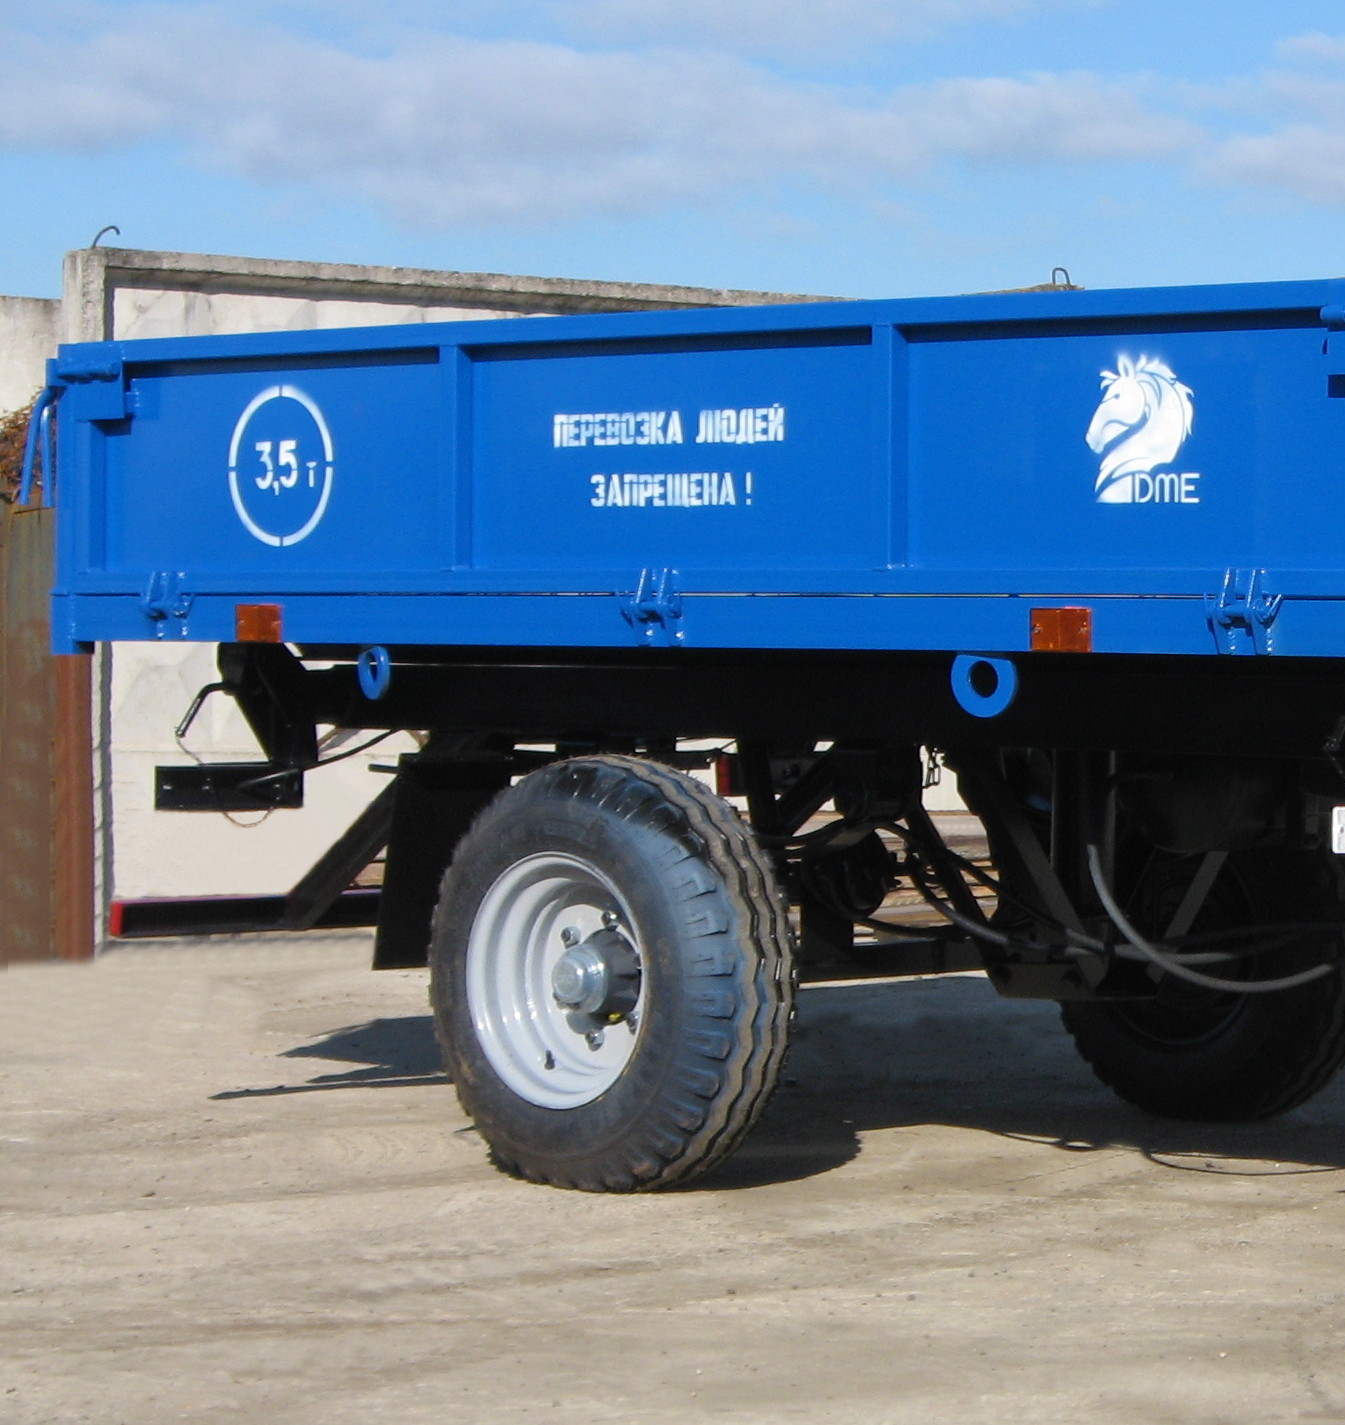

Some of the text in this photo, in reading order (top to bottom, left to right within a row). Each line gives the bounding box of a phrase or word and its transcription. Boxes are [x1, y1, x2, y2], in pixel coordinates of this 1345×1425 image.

[552, 402, 786, 448] ПЕРЕВОЗКА ЛЮДЕЙ
[254, 438, 299, 496] 3,5
[590, 471, 737, 508] ЗАПРЕЩЕНА
[1134, 472, 1200, 504] DME
